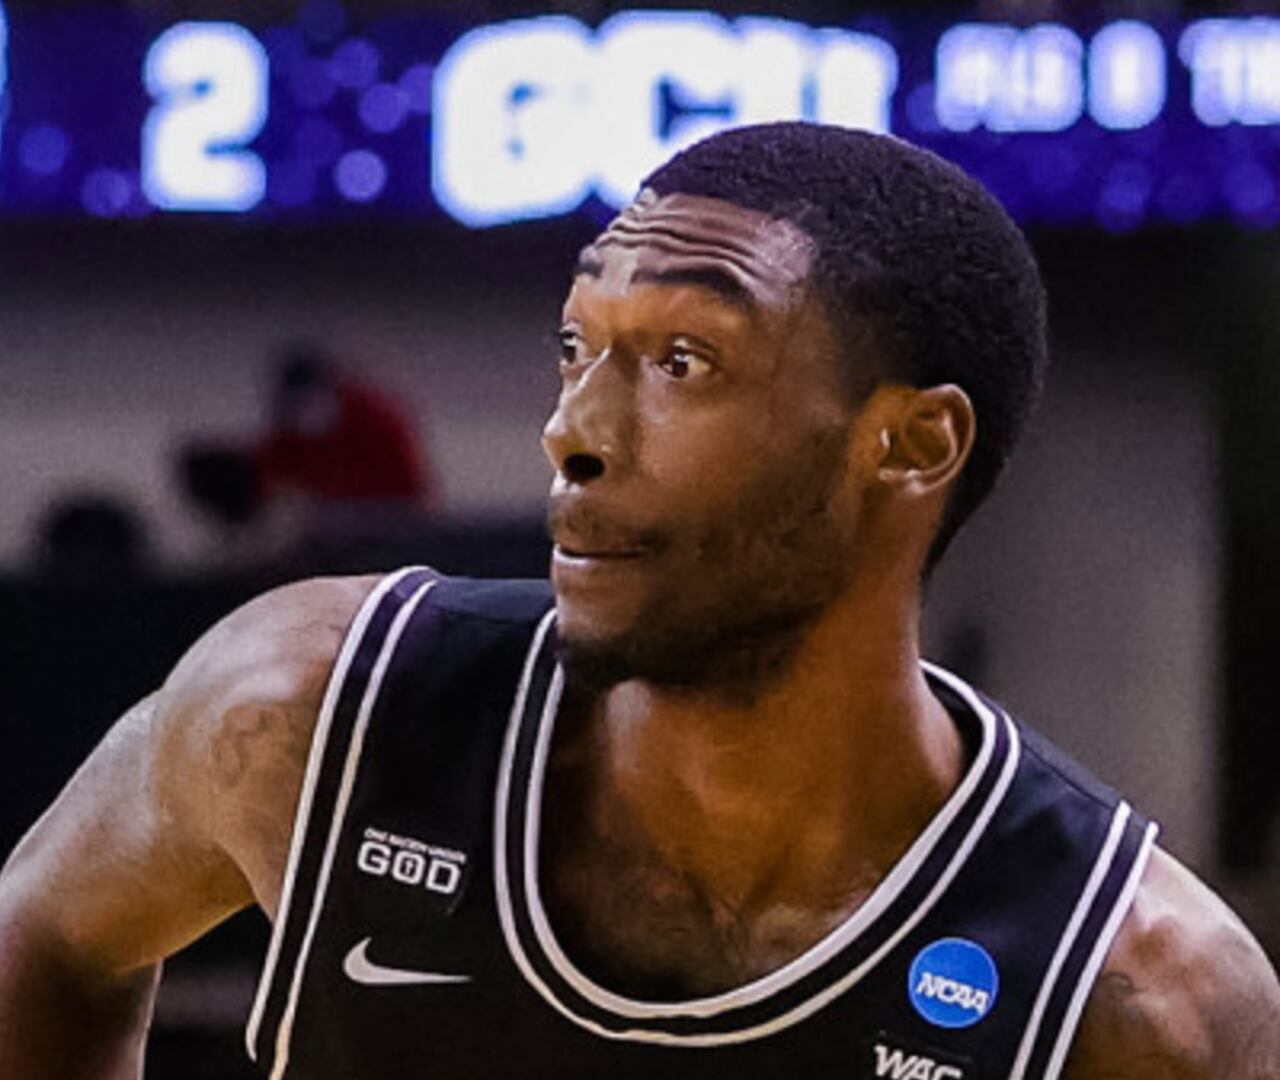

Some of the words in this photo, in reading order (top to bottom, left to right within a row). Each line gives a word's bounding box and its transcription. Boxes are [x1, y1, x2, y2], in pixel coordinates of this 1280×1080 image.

[142, 22, 269, 211] 2
[357, 840, 461, 894] GOD
[916, 971, 990, 1016] NCAA
